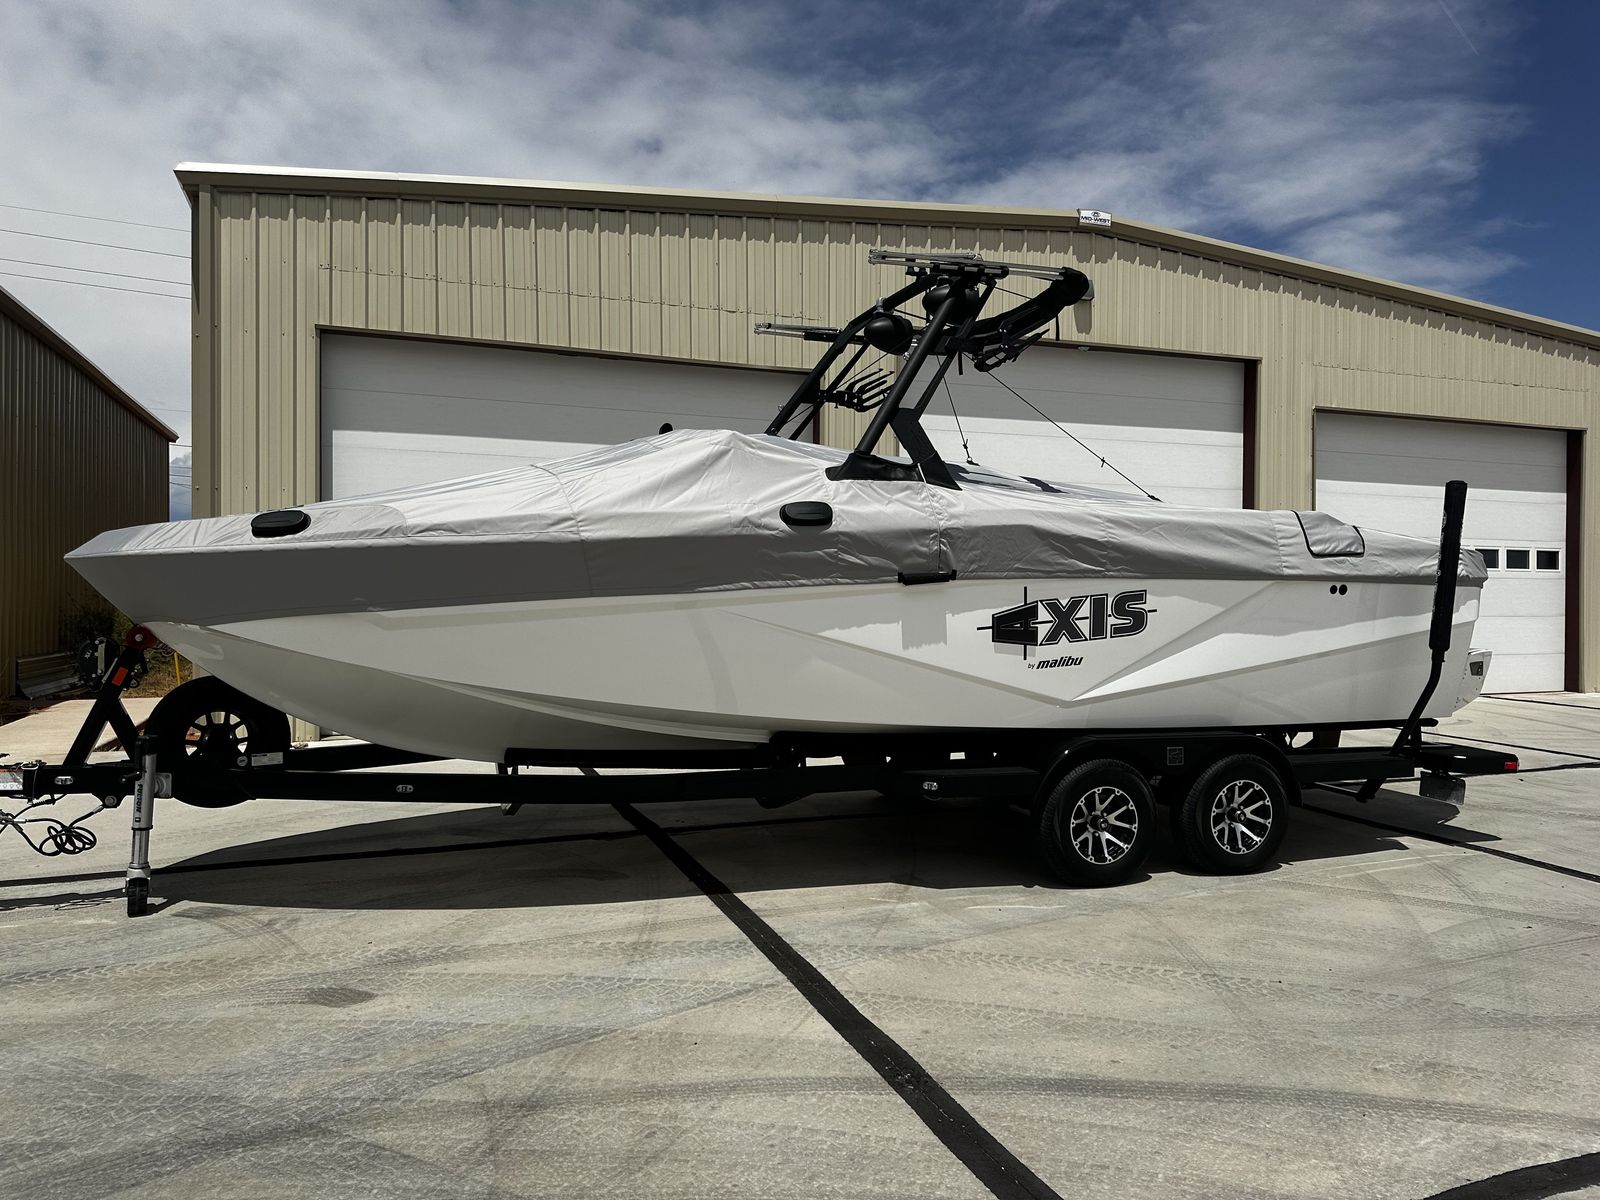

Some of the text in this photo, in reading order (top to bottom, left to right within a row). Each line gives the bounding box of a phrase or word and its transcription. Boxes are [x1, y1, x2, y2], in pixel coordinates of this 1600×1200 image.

[991, 589, 1148, 646] AXIS
[1027, 656, 1084, 670] by malibu
